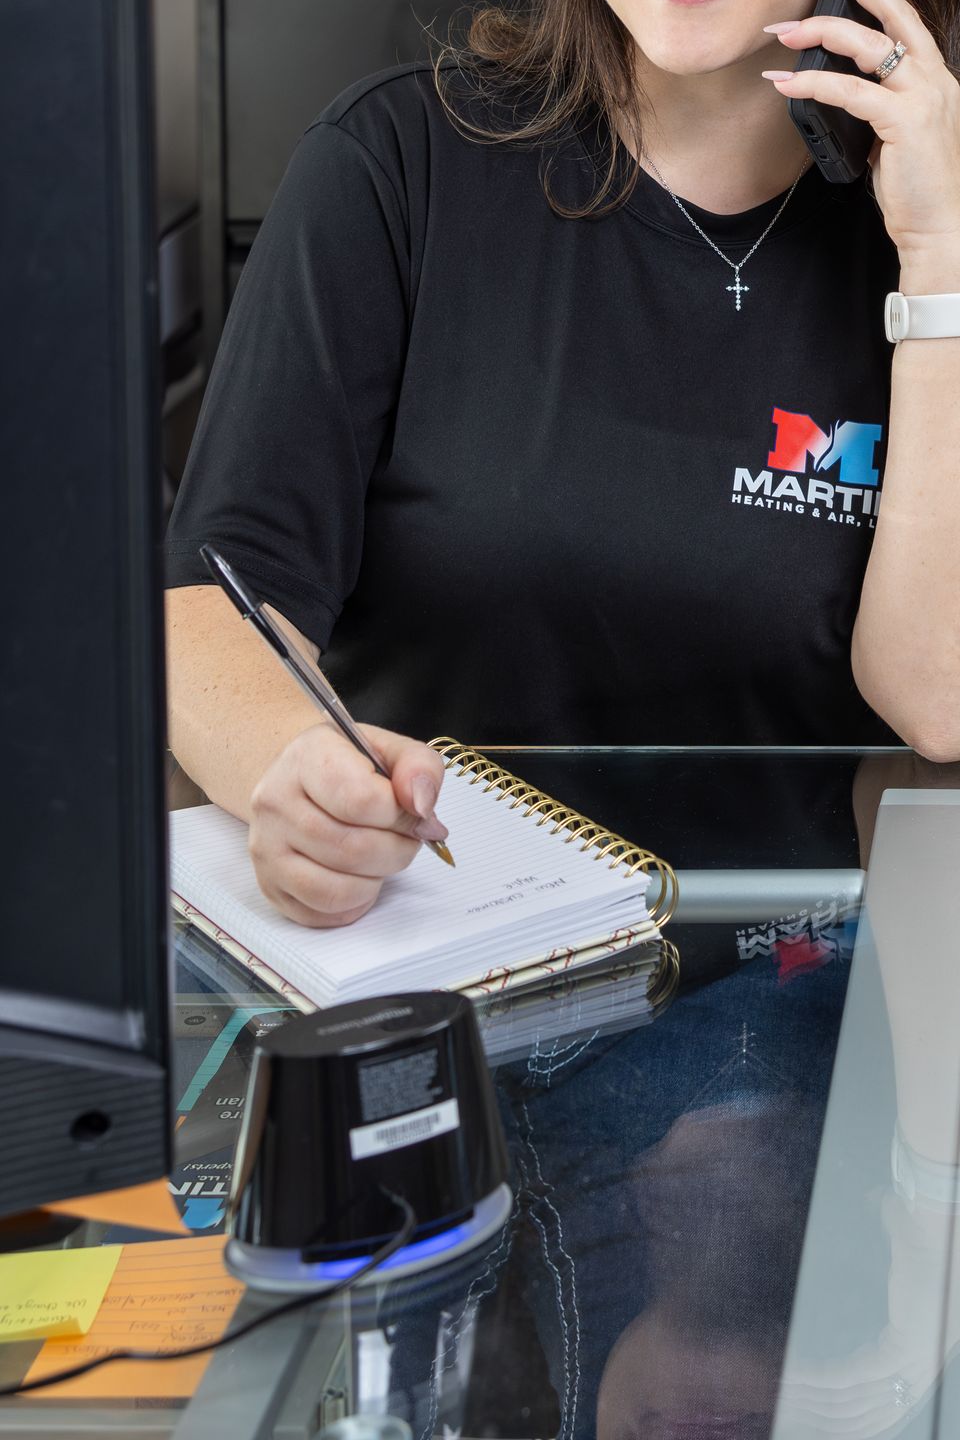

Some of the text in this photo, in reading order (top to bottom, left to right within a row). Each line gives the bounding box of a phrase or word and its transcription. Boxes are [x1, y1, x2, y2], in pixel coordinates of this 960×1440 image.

[731, 493, 805, 515] HEATING
[811, 507, 821, 518] &
[827, 511, 862, 527] AIR,
[219, 1110, 243, 1120] re
[182, 1162, 233, 1172] xperts!
